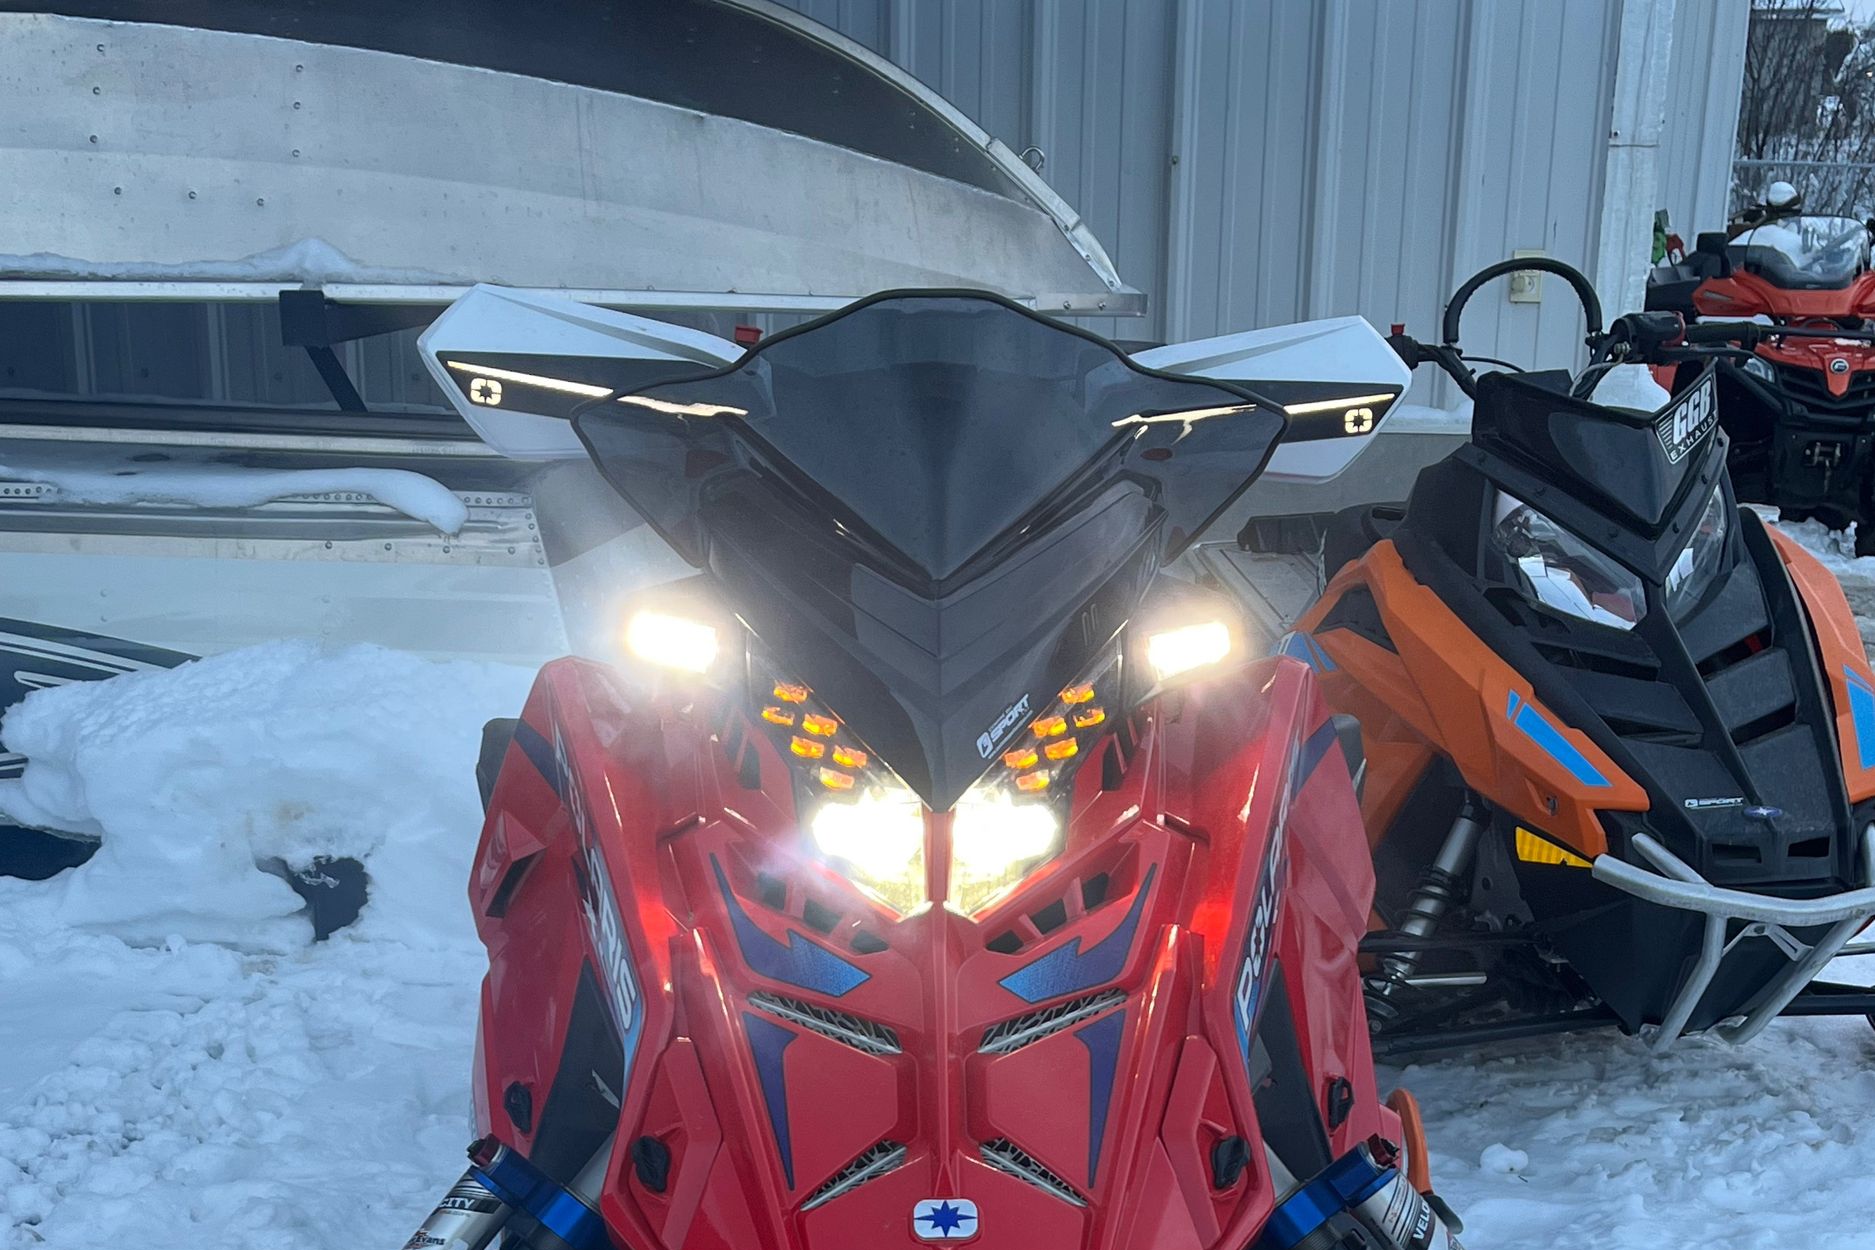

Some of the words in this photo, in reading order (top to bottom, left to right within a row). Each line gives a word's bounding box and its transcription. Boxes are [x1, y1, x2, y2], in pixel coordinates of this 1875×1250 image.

[1670, 409, 1718, 460] EXHAUST
[1673, 380, 1711, 445] GGB
[990, 693, 1029, 743] SPORT
[555, 720, 637, 1031] POLARIS
[1235, 726, 1301, 1031] POLAR
